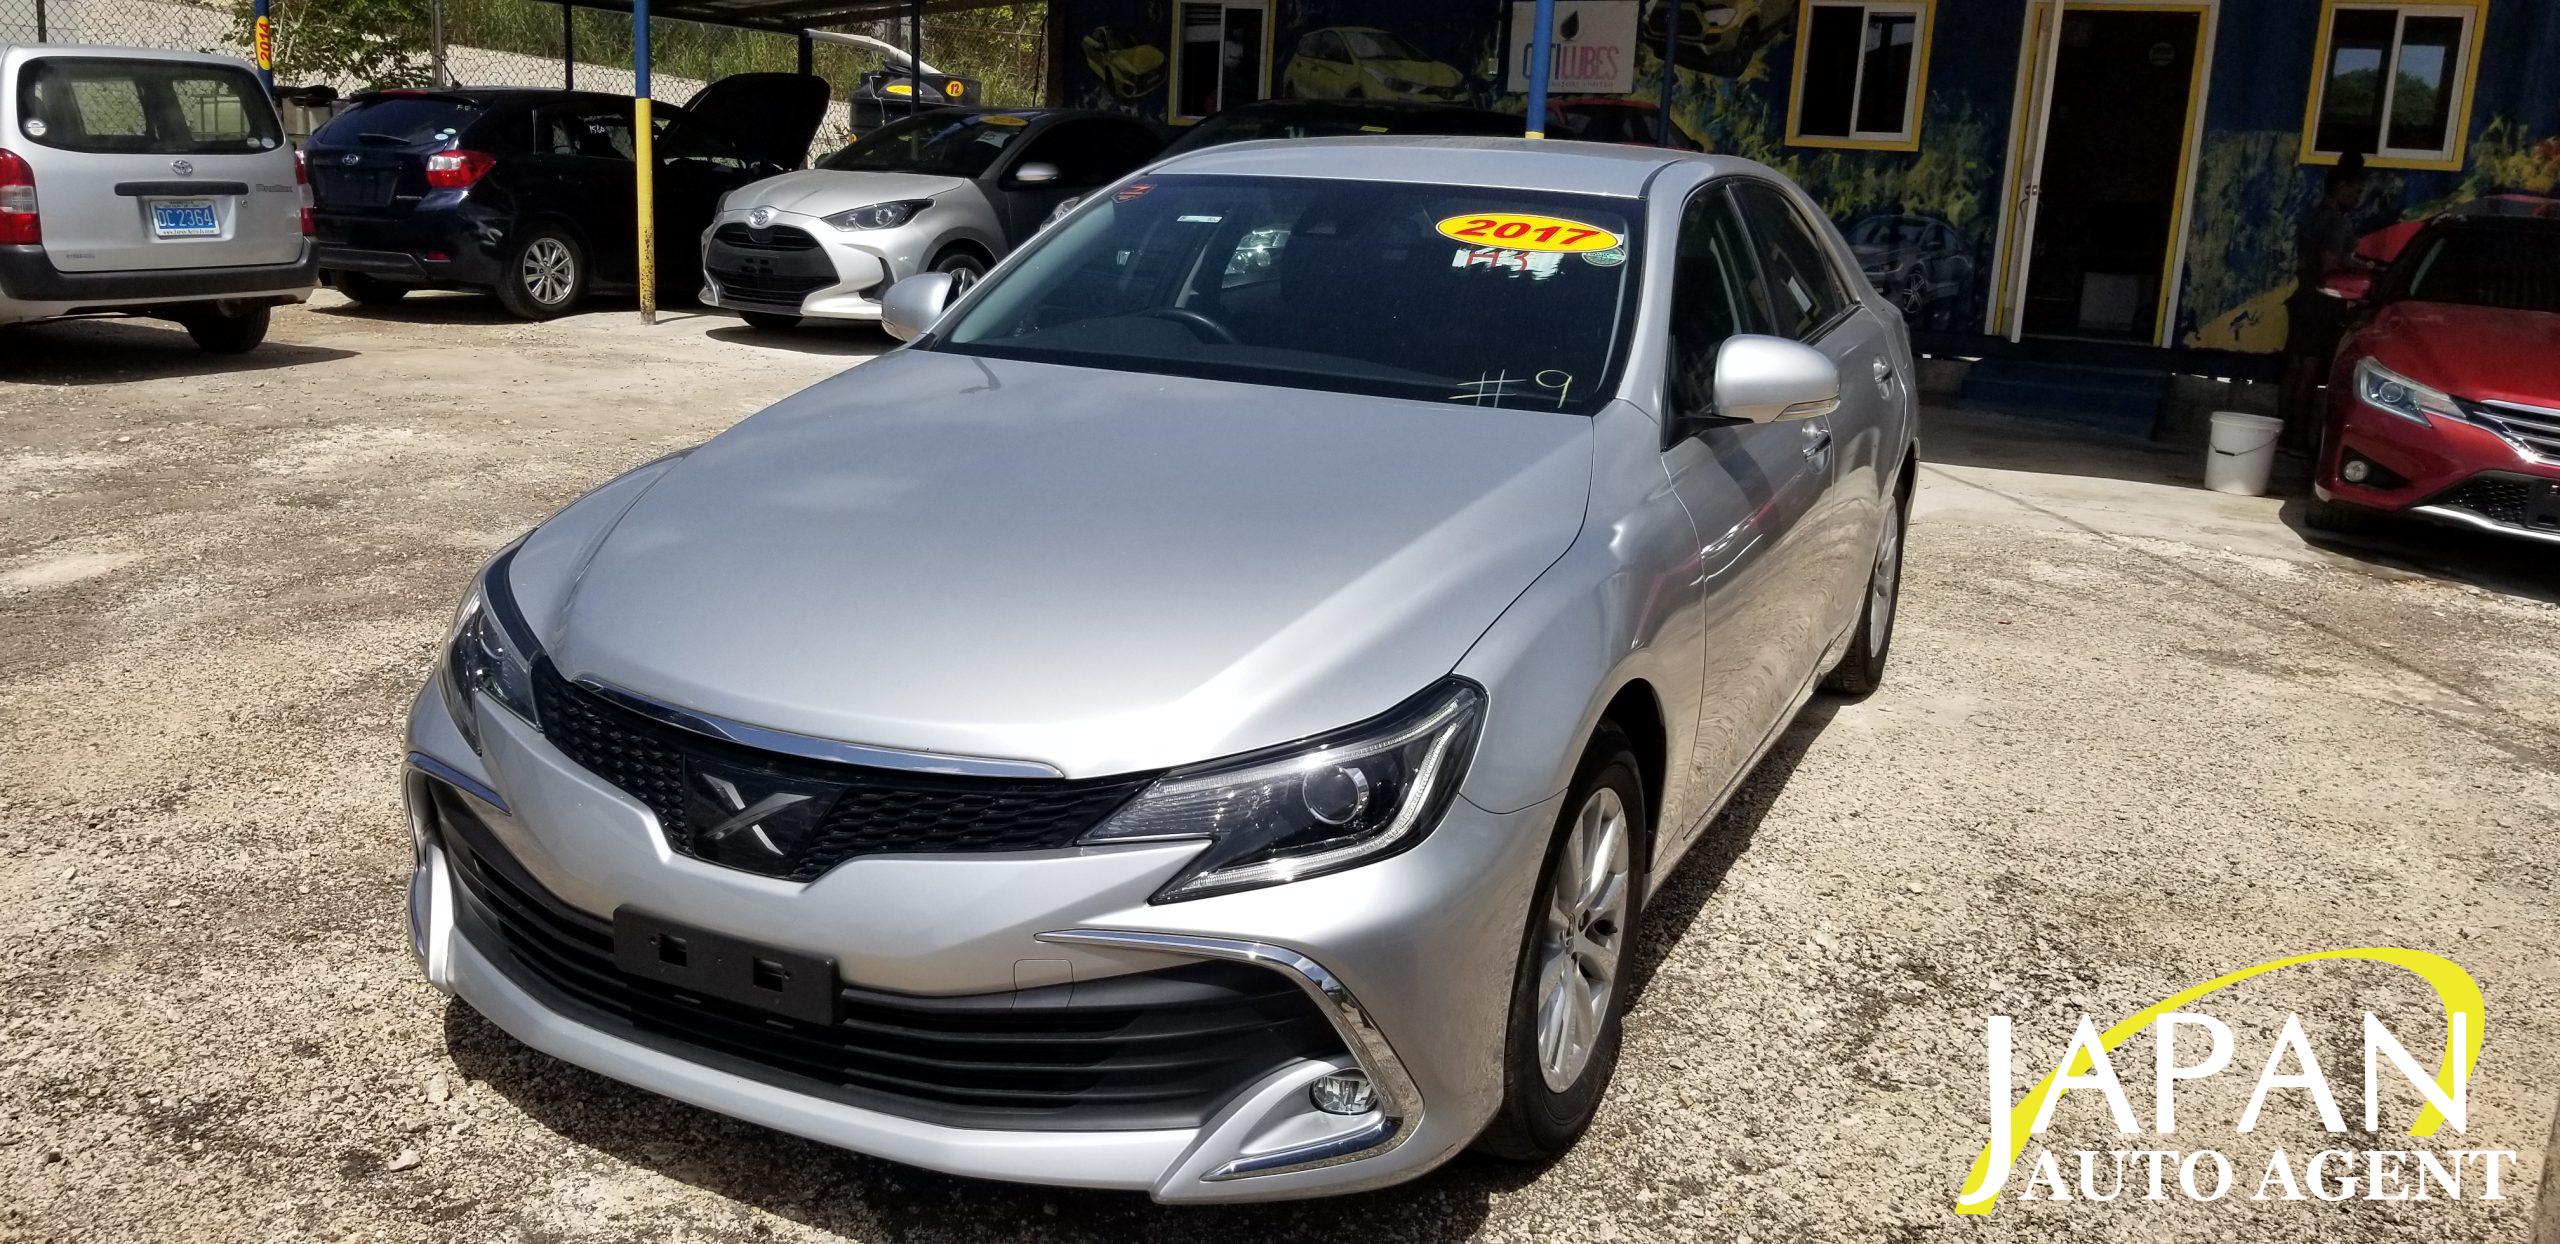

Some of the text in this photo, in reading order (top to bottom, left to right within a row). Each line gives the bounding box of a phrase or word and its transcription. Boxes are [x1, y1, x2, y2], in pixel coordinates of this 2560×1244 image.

[258, 22, 272, 66] 2014
[157, 208, 214, 227] DC 2364
[1454, 219, 1601, 245] 2017
